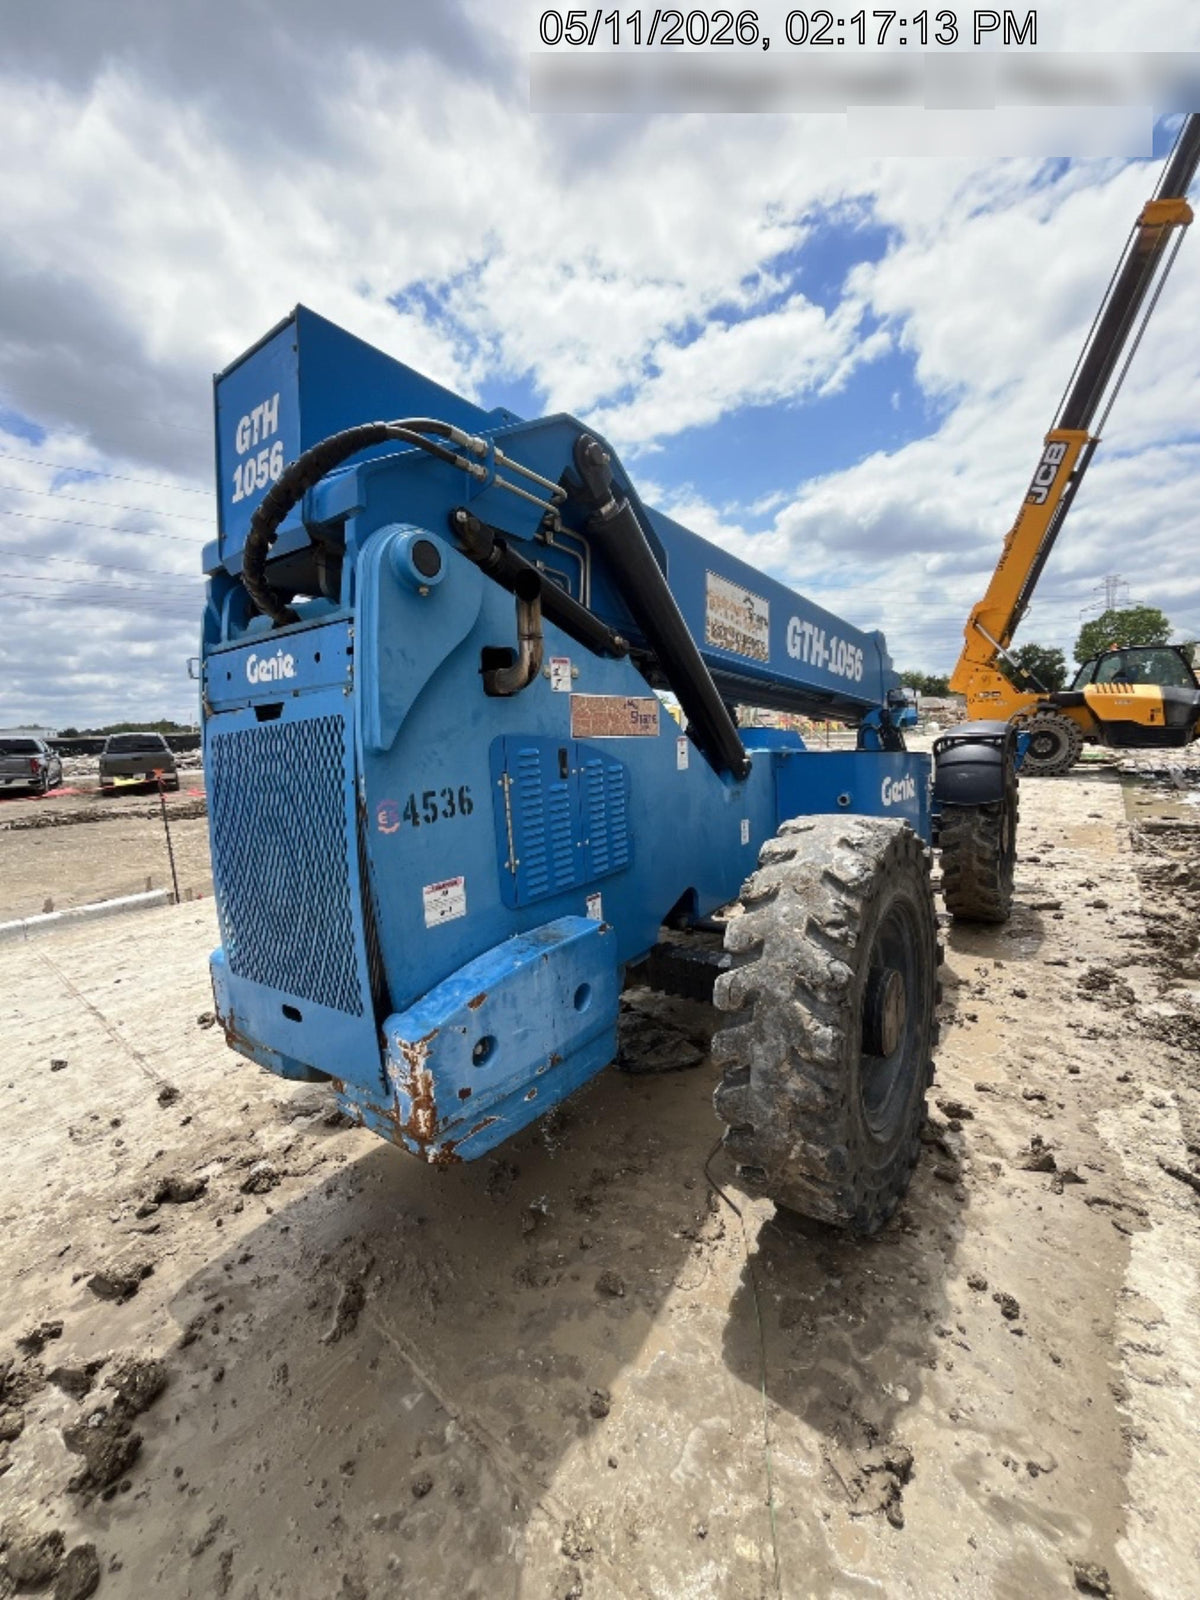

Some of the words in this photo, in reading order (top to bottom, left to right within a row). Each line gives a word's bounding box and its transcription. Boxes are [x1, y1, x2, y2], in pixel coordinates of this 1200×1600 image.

[236, 393, 280, 455] GTH
[232, 441, 284, 503] 1056
[1031, 442, 1067, 504] JCB
[246, 649, 295, 684] Genie
[787, 617, 863, 682] GTH-1056
[403, 786, 474, 826] 4536
[882, 772, 914, 806] Genie
